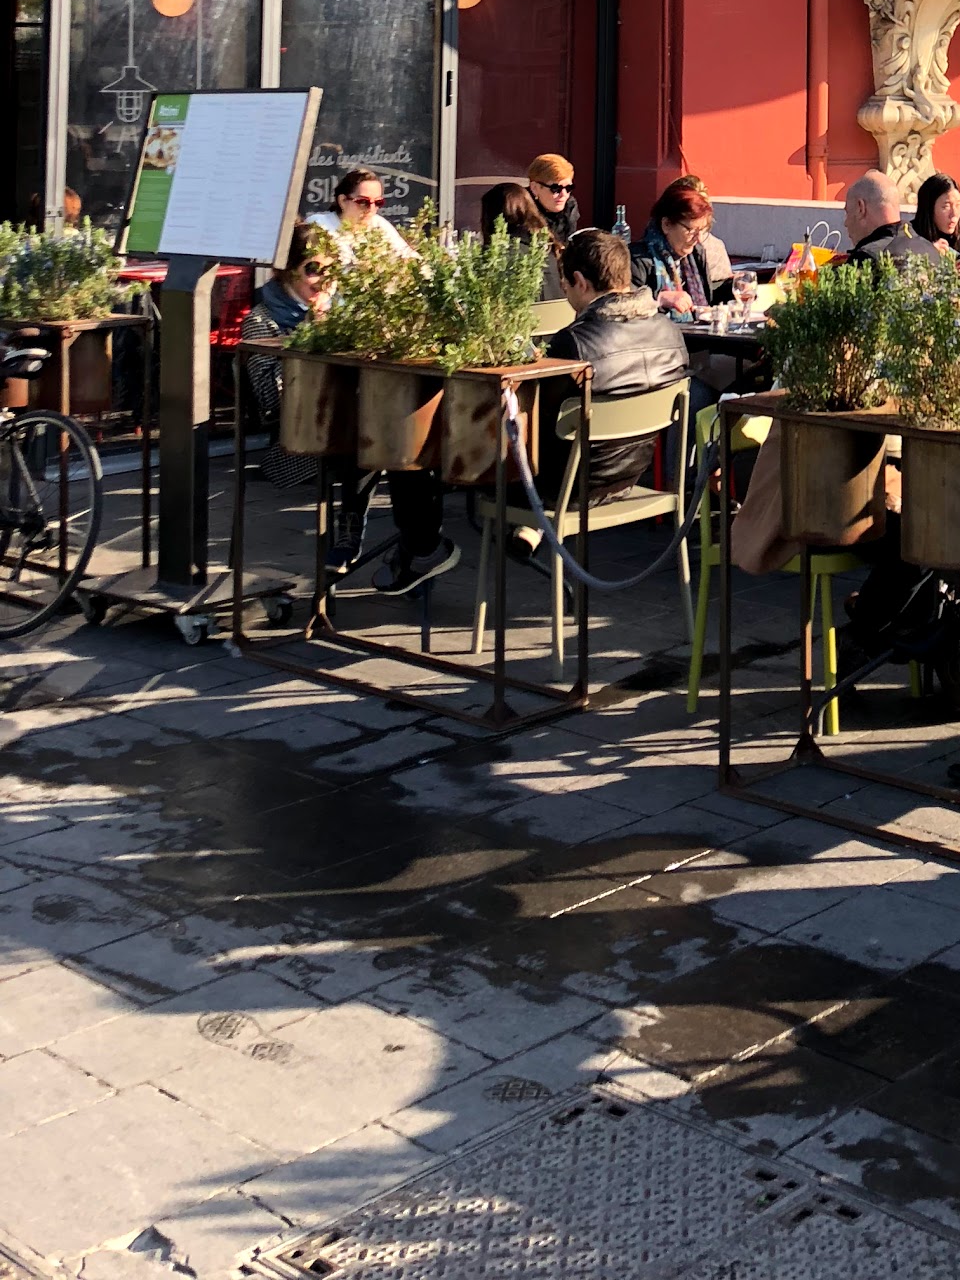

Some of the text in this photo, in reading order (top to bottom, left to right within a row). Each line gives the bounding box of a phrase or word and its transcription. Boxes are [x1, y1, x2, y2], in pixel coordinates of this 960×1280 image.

[309, 145, 413, 169] des ingrédients
[307, 175, 410, 203] SIES
